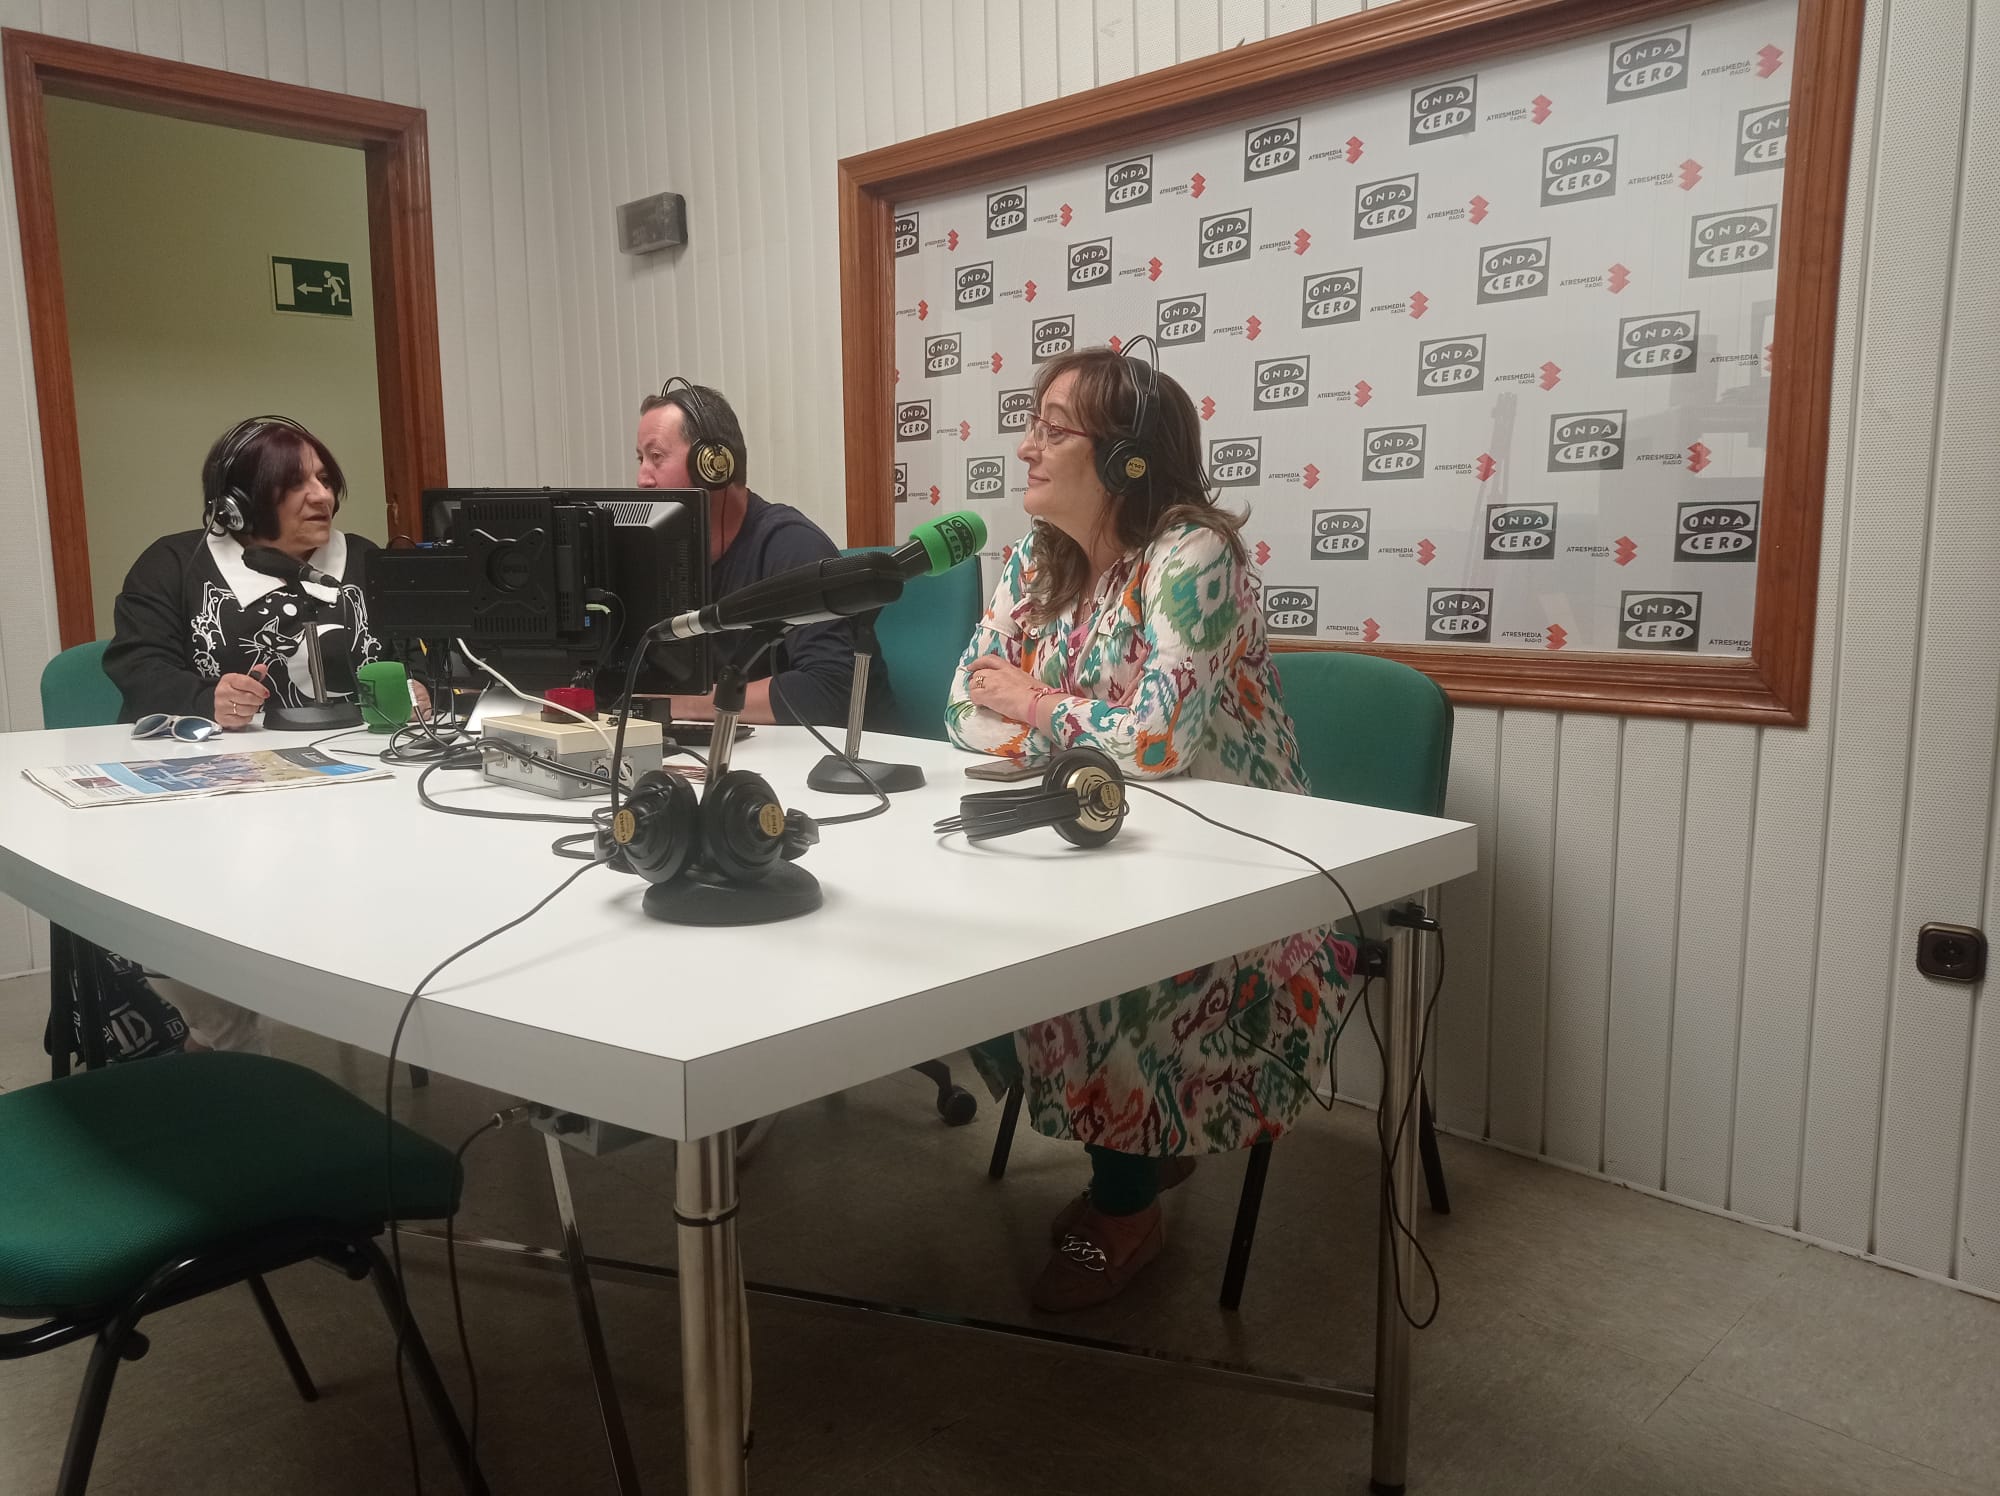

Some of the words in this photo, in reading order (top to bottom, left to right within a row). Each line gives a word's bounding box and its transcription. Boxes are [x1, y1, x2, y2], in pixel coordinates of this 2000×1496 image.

[1622, 43, 1675, 65] ONDA
[1701, 61, 1750, 77] ATRESMEDIA
[1624, 65, 1674, 88] CERO
[1422, 91, 1466, 111] ONDA
[1423, 111, 1465, 131] CERO
[1487, 108, 1528, 122] ATRESMEDIA
[1752, 116, 1787, 135] ON
[1254, 132, 1291, 150] ONDA
[1754, 141, 1778, 158] CE
[1255, 150, 1290, 169] CERO
[1554, 151, 1604, 171] ONDA
[1113, 167, 1144, 184] ONDA
[1555, 172, 1603, 193] CERO
[1628, 173, 1674, 185] ATRESMEDIA
[1114, 184, 1144, 201] CERO
[1365, 188, 1407, 206] ONDA
[993, 197, 1020, 212] ONDA
[994, 213, 1020, 228] CERO
[1366, 208, 1406, 226] CERO
[1427, 208, 1465, 220] ATRESMEDIA
[1207, 221, 1242, 237] ONDA
[1704, 221, 1759, 240] ONDA
[1208, 239, 1242, 256] CERO
[1705, 244, 1759, 264] CERO
[1074, 249, 1104, 263] ONDA
[1490, 253, 1537, 270] ONDA
[961, 272, 987, 285] ONDA
[1075, 265, 1104, 280] CERO
[1491, 273, 1536, 291] CERO
[1560, 276, 1603, 287] ATRESMEDIA
[962, 287, 987, 301] CERO
[1312, 281, 1351, 297] ONDA
[1163, 305, 1197, 319] ONDA
[1313, 300, 1351, 316] CERO
[1370, 303, 1407, 313] ATRESMEDIA
[1038, 325, 1066, 338] ONDA
[1165, 322, 1197, 337] CERO
[1632, 326, 1684, 343] ONDA
[930, 342, 955, 354] ONDA
[1039, 341, 1066, 354] CERO
[1429, 348, 1473, 363] ONDA
[1633, 348, 1683, 365] CERO
[1710, 354, 1758, 363] ATRESMEDIA
[931, 357, 955, 369] CERO
[1263, 368, 1300, 381] ONDA
[1431, 368, 1473, 384] CERO
[1495, 374, 1535, 382] ATRESMEDIA
[1264, 386, 1299, 400] CERO
[901, 409, 925, 420] ONDA
[902, 423, 925, 434] CERO
[1562, 424, 1611, 438] ONDA
[1373, 437, 1414, 450] ONDA
[1217, 449, 1252, 460] ONDA
[1563, 444, 1610, 460] CERO
[1374, 456, 1414, 470] CERO
[973, 466, 998, 476] ONDA
[1218, 466, 1251, 479] CERO
[974, 480, 999, 491] CERO
[1321, 520, 1360, 531] ONDA
[1497, 515, 1543, 527] ONDA
[1689, 514, 1744, 527] ONDA
[1322, 538, 1359, 550] CERO
[1498, 534, 1543, 548] CERO
[1690, 535, 1743, 550] CERO
[1272, 597, 1309, 607] ONDA
[1437, 600, 1481, 610] ONDA
[1634, 604, 1686, 616] ONDA
[1273, 613, 1308, 627] CERO
[1438, 617, 1480, 632] CERO
[1635, 623, 1685, 639] CERO
[1709, 639, 1751, 647] ATRESMED
